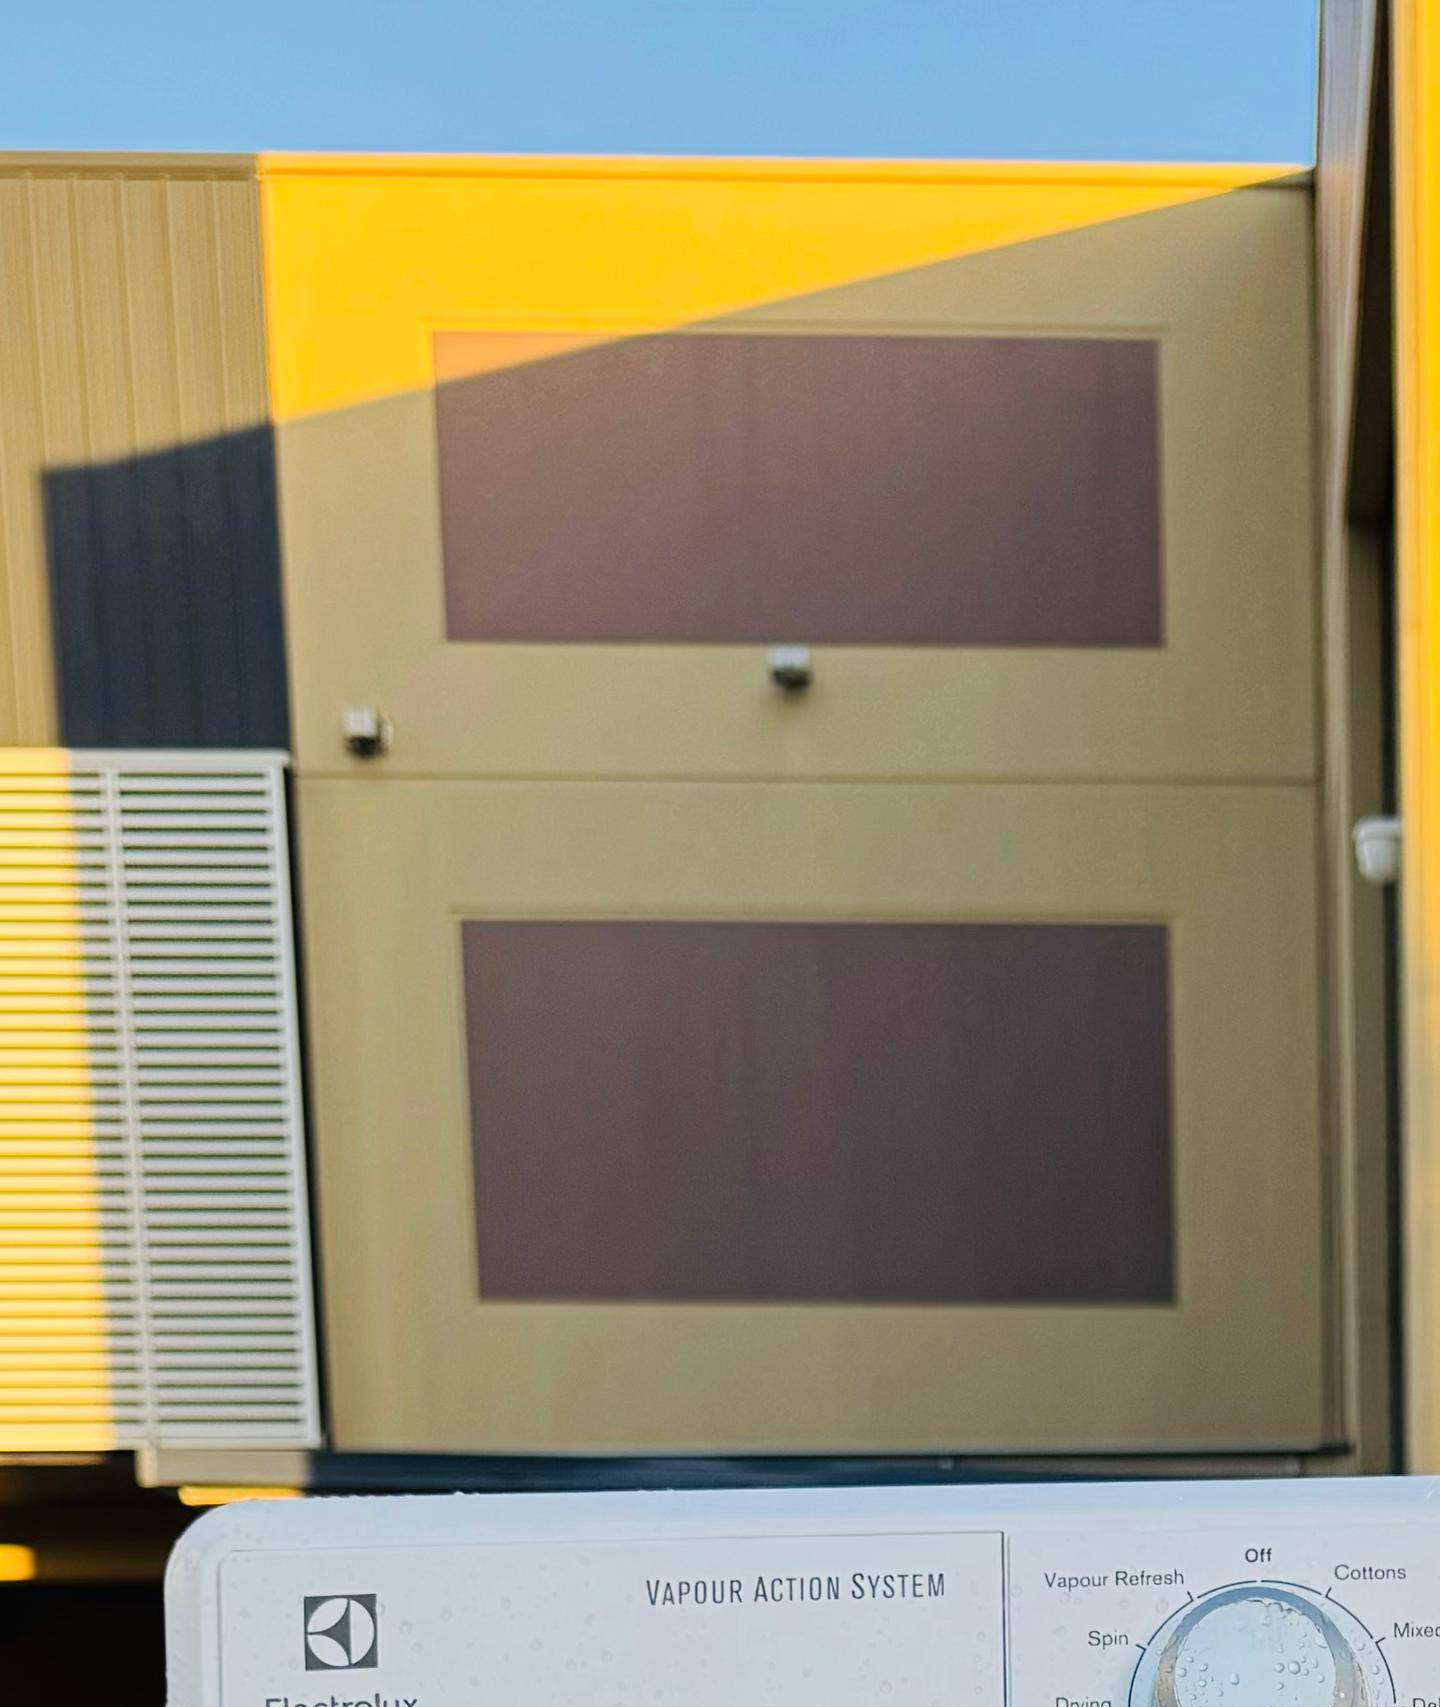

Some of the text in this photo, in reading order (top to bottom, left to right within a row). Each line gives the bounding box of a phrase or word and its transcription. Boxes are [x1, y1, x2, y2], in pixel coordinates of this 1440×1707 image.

[1244, 1547, 1273, 1563] Off
[1044, 1568, 1185, 1591] Vapour Refresh
[1334, 1564, 1407, 1581] Cottons
[646, 1571, 946, 1606] VAPOUR ACTION SYSTEM
[1088, 1631, 1129, 1650] Spin
